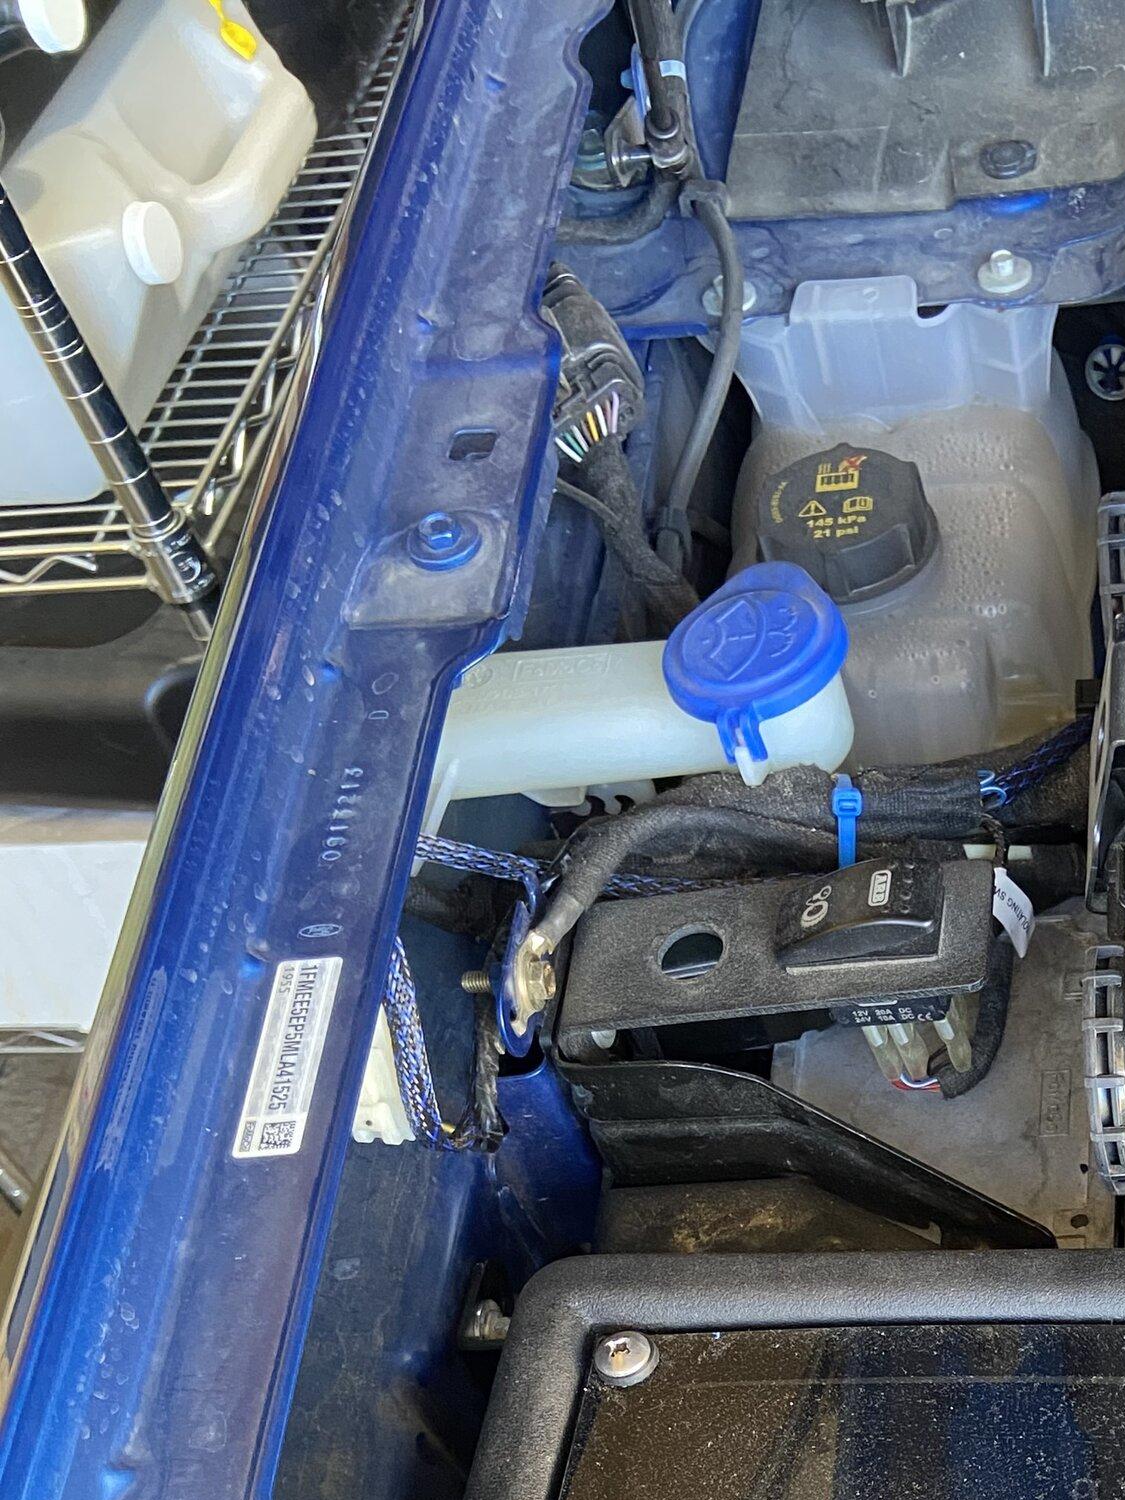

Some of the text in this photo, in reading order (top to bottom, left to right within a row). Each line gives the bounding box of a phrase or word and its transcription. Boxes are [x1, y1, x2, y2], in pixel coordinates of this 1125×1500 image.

[806, 515, 867, 528] 145 kPa
[813, 526, 859, 539] 21 psi
[268, 964, 318, 1112] 1FMEE5EP5MLA41525
